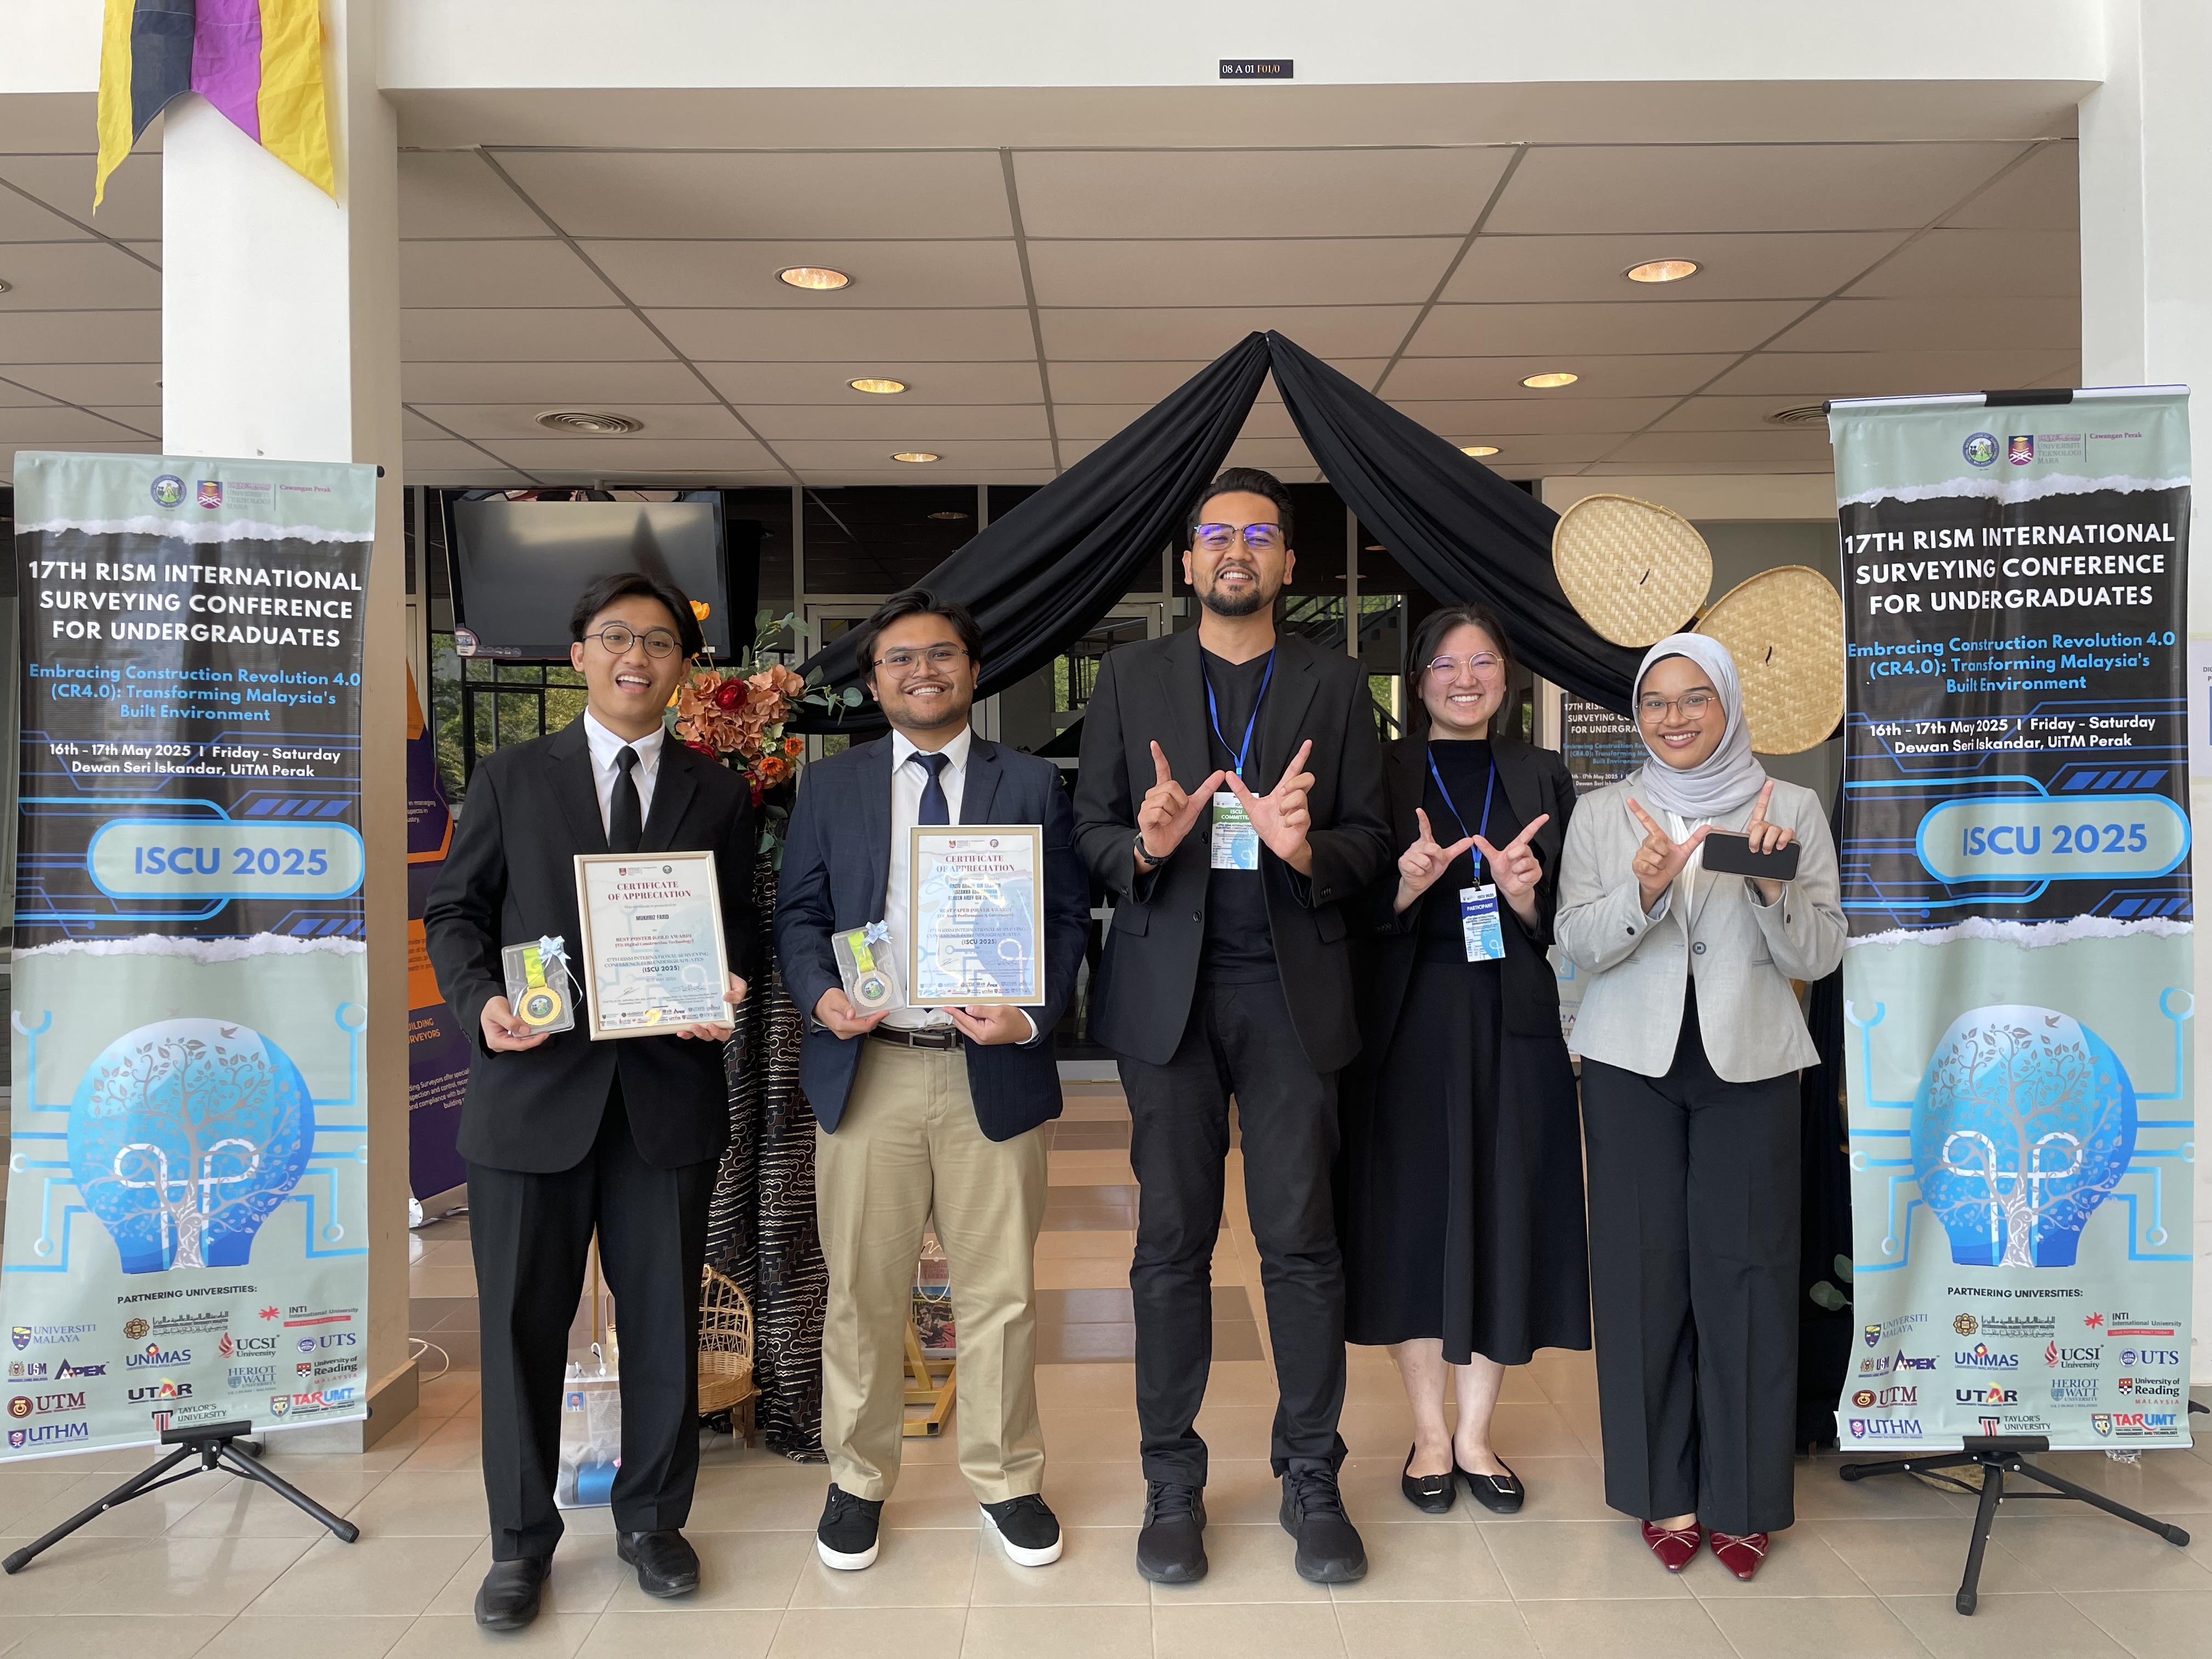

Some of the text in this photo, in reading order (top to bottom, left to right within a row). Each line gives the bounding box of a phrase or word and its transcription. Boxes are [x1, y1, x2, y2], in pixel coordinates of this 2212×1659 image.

[1222, 65, 1233, 73] 08
[1235, 65, 1243, 73] A
[1245, 65, 1254, 73] 01
[280, 484, 313, 493] Cawangan
[1845, 523, 2175, 554] 17TH RISM INTERNATIONAL
[29, 561, 362, 590] 17TH RISM INTERNATIONAL
[1856, 554, 2164, 585] SURVEYING CONFERENCE
[40, 590, 352, 618] SURVEYING CONFERENCE
[1870, 585, 2153, 615] FOR UNDERGRADUATES
[53, 620, 340, 647] FOR UNDERGRADUATES
[1848, 631, 2175, 657] Embracing Construction Revolution 4.0
[1870, 652, 2150, 680] (CR4.0): Transforming Malaysia's
[30, 664, 360, 686] Embracing Construction Revolution 4.0
[1947, 676, 2086, 693] Built Environment
[52, 684, 336, 707] (CR4.0): Transforming Malaysia's
[121, 704, 270, 721] Built Environment
[1565, 703, 1583, 711] 17TH
[1567, 714, 1615, 723] SURVEYING
[1870, 714, 2156, 737] 16th 17th May 2025 Friday Saturday
[1895, 733, 2132, 754] Dewan Seri Iskandar, UiTM Perak
[50, 743, 341, 764] 16th 17th May 2025 Friday Saturday
[72, 761, 315, 777] Dewan Seri Iskandar, UiTM Perak
[1963, 823, 2147, 856] ISCU 2025
[135, 847, 328, 876] ISCU 2025
[950, 864, 1015, 872] APPRECIATION
[617, 881, 679, 890] CERTIFICATE
[623, 890, 691, 900] APPRECIATION
[1467, 902, 1493, 911] PARTICIPANT
[408, 1029, 441, 1043] RVEYORS
[117, 1285, 257, 1304] PARTNERING UNIVERSITIES:
[1948, 1287, 2084, 1298] PARTNERING UNIVERSITIES:
[289, 1307, 359, 1318] International University
[33, 1324, 96, 1334] UNIVERSITI
[1883, 1314, 1927, 1330] UNIVERSITI
[1882, 1324, 1913, 1339] MALAYA
[33, 1335, 80, 1344] MALAYA
[235, 1338, 276, 1350] UCSI
[319, 1333, 356, 1348] UTS
[2061, 1347, 2100, 1361] UCSI
[2141, 1350, 2179, 1365] UTS
[27, 1363, 47, 1375] USM
[314, 1358, 349, 1367] University
[314, 1363, 358, 1376] Reading
[1877, 1356, 1889, 1370] USM
[2061, 1361, 2100, 1370] University
[228, 1365, 276, 1376] HERIOT
[241, 1373, 276, 1384] WATT
[2052, 1379, 2099, 1387] HERIOT
[2135, 1378, 2171, 1386] University
[128, 1383, 192, 1400] UTAR
[1880, 1386, 1917, 1405] UTM
[1956, 1388, 2018, 1403] UTAR
[2066, 1388, 2099, 1397] WATT
[2135, 1385, 2180, 1397] Reading
[36, 1391, 86, 1410] UTM
[178, 1403, 217, 1414] TAYLOR'S
[178, 1410, 227, 1421] UNIVERSITY
[29, 1422, 88, 1441] UTHM
[1867, 1419, 1922, 1434] UTHM
[2004, 1423, 2051, 1431] UNIVERSITY
